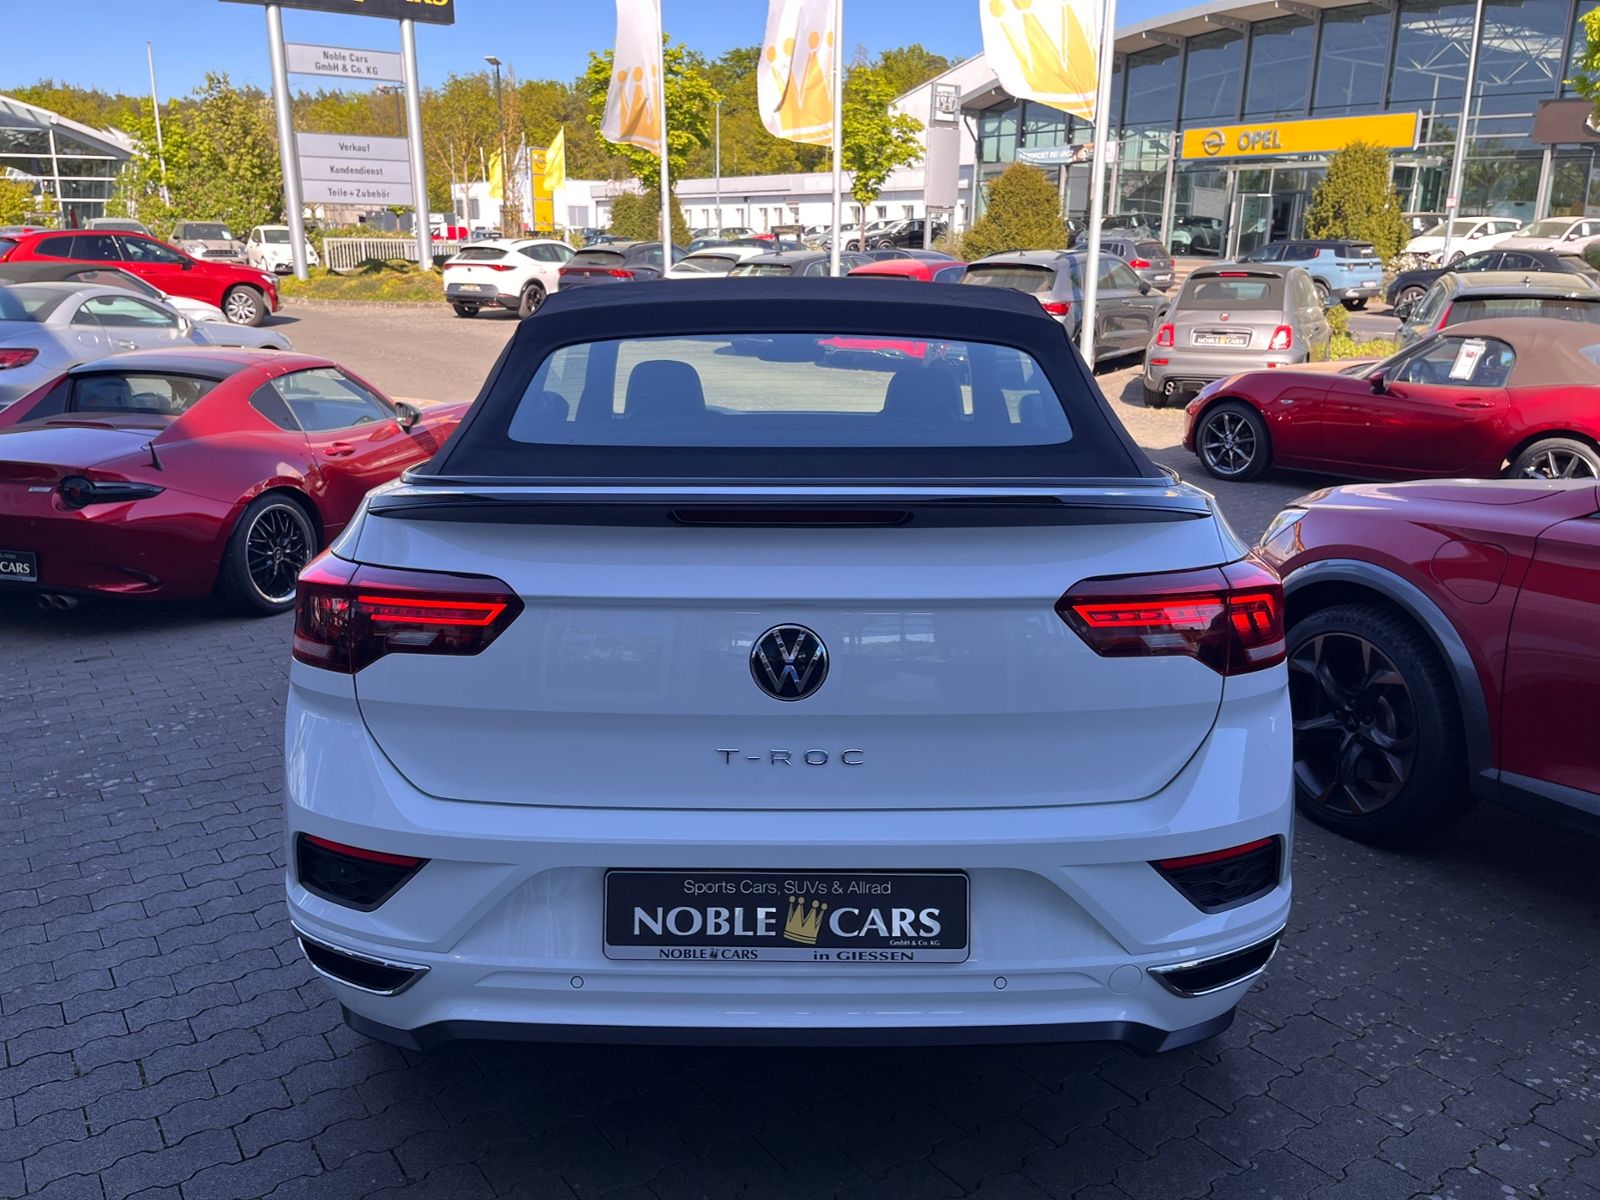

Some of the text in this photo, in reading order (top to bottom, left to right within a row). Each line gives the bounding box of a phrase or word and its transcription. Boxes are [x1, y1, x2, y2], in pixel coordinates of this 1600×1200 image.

[323, 51, 369, 63] Noble Cars
[315, 61, 378, 75] GmbH & Co. KG
[1238, 129, 1282, 151] OPEL
[338, 142, 371, 153] Verkauf
[329, 165, 384, 176] Kundendienst
[0, 561, 30, 574] CARS
[716, 748, 865, 766] T-ROC
[683, 880, 892, 896] Sports Cars, SUVs & Allrad
[633, 907, 941, 938] NOBLE CARS
[659, 948, 758, 960] NOBLE CARS
[813, 951, 914, 961] in GIESSEN
